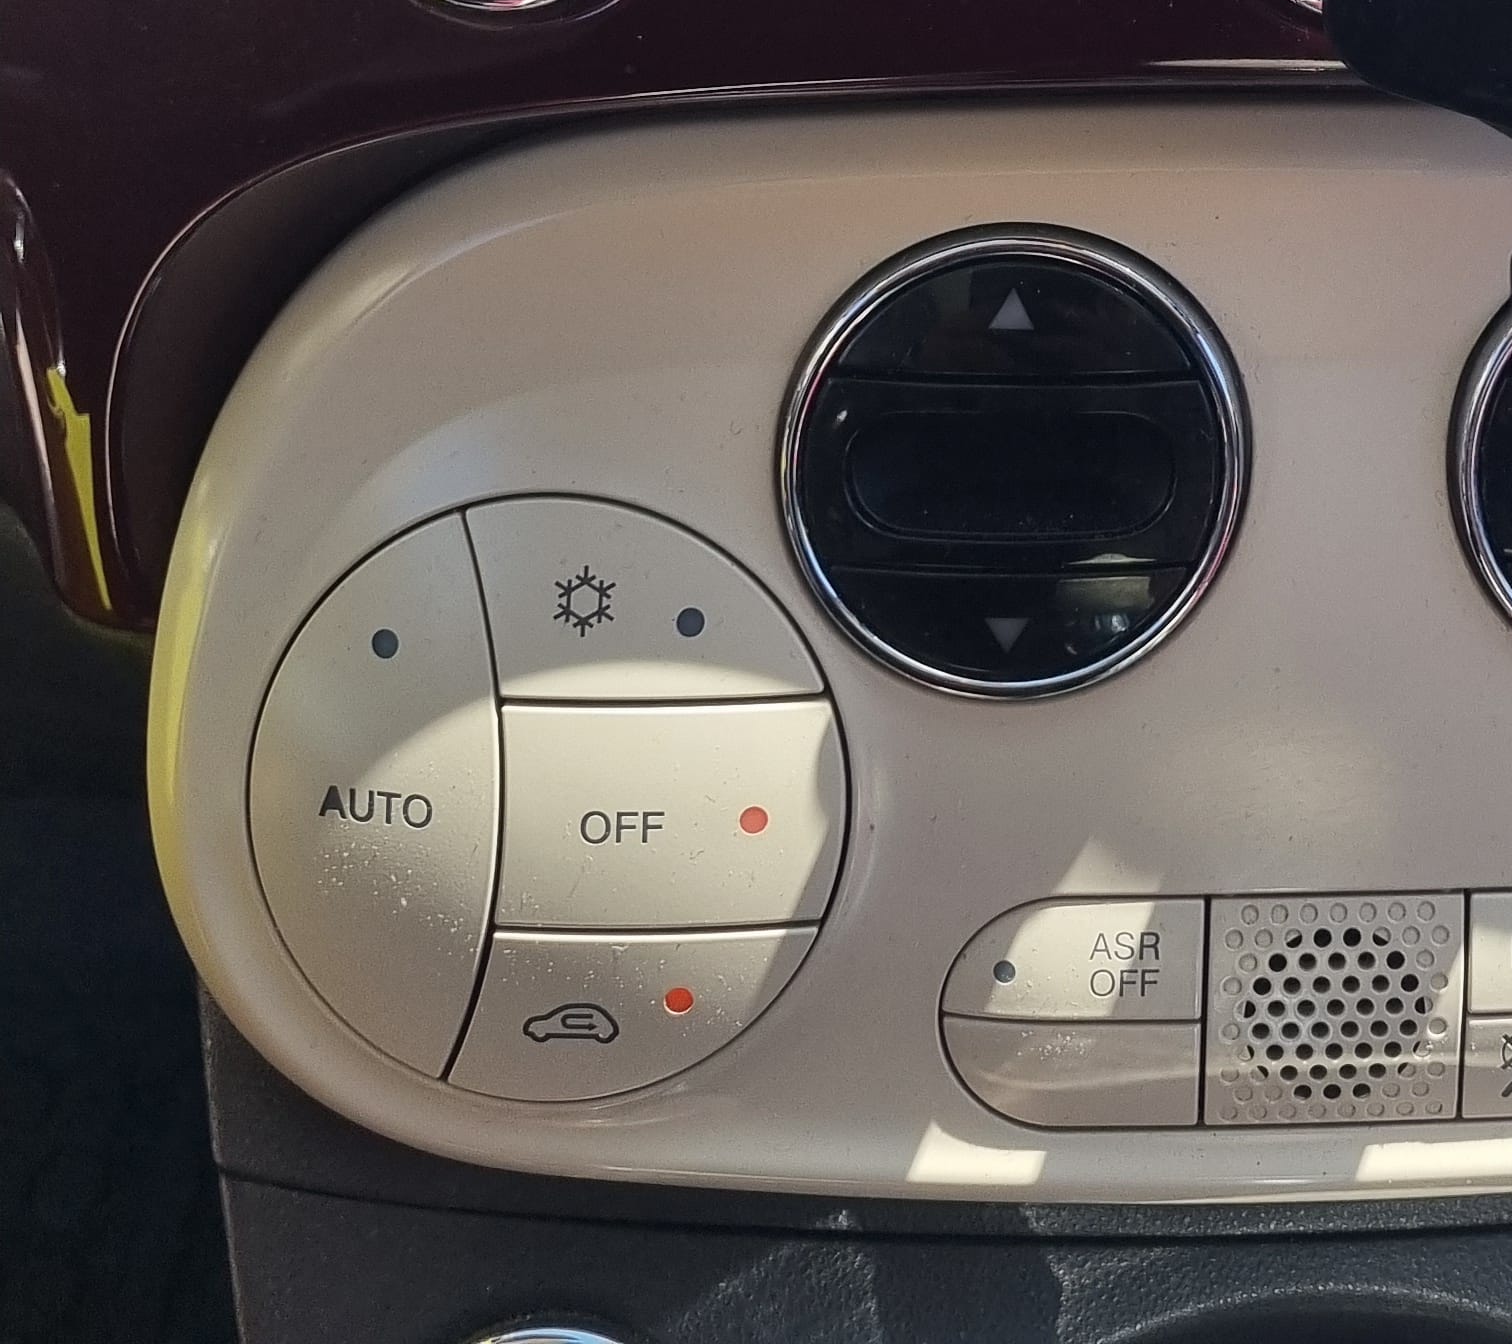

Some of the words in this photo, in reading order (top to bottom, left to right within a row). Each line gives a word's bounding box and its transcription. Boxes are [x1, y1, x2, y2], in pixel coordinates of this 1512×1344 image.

[318, 784, 434, 830] AUTO
[579, 810, 666, 846] OFF
[1088, 930, 1162, 961] ASR
[1088, 968, 1161, 998] OFF
